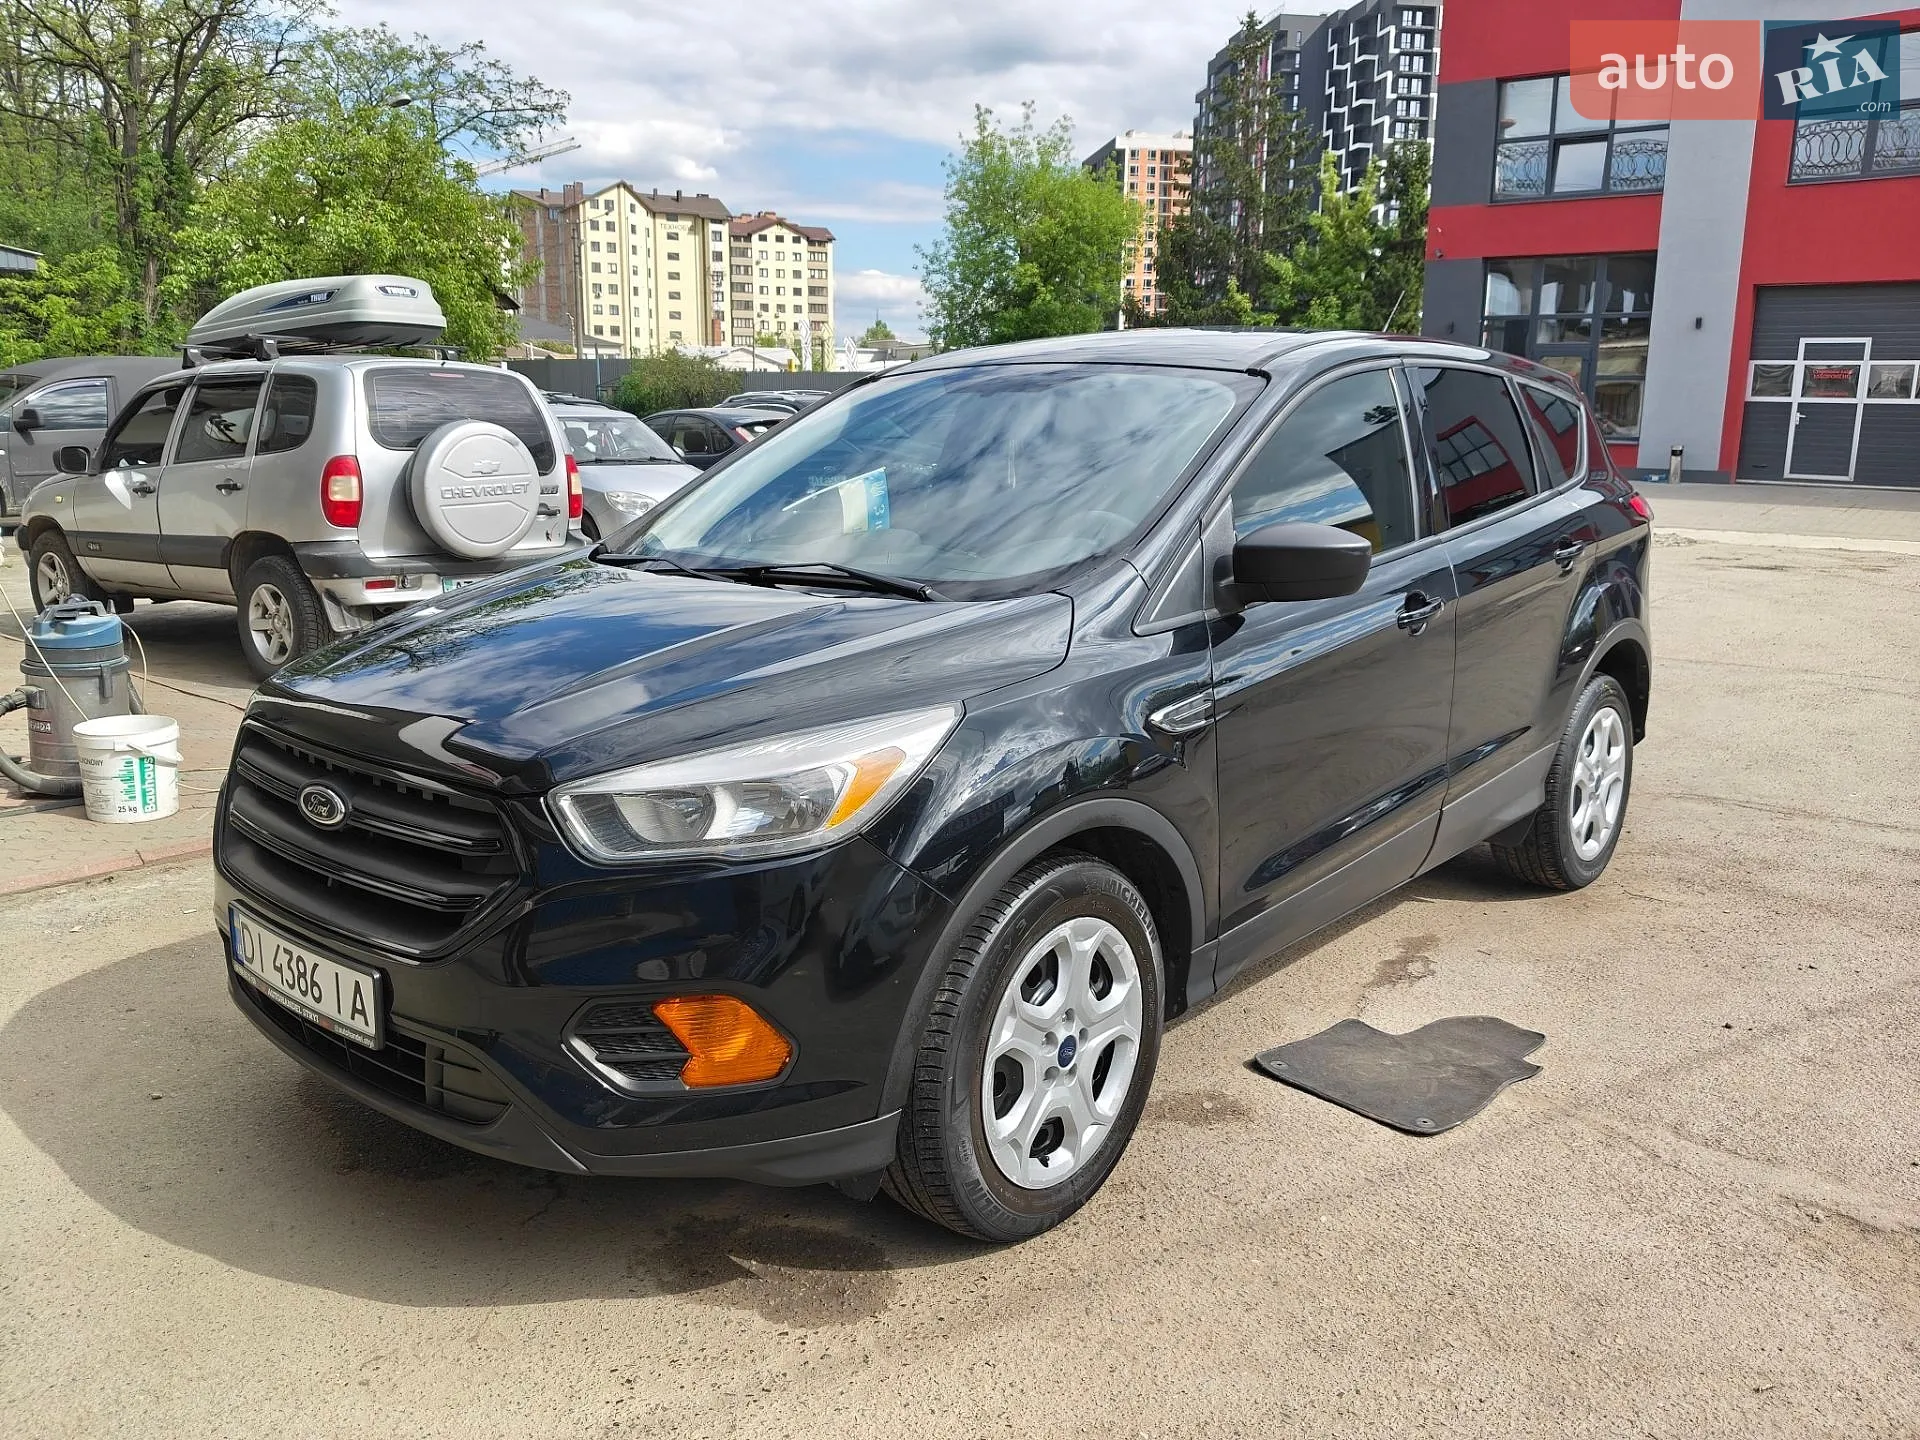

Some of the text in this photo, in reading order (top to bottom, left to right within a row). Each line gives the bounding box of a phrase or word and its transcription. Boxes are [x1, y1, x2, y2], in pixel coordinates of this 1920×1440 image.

[440, 482, 529, 499] CHEVROLET
[144, 757, 156, 813] Bauhaus
[128, 805, 138, 813] kg
[307, 794, 330, 816] Ford
[1101, 876, 1158, 944] MICHELIN
[241, 921, 369, 1027] DI 4386 IA
